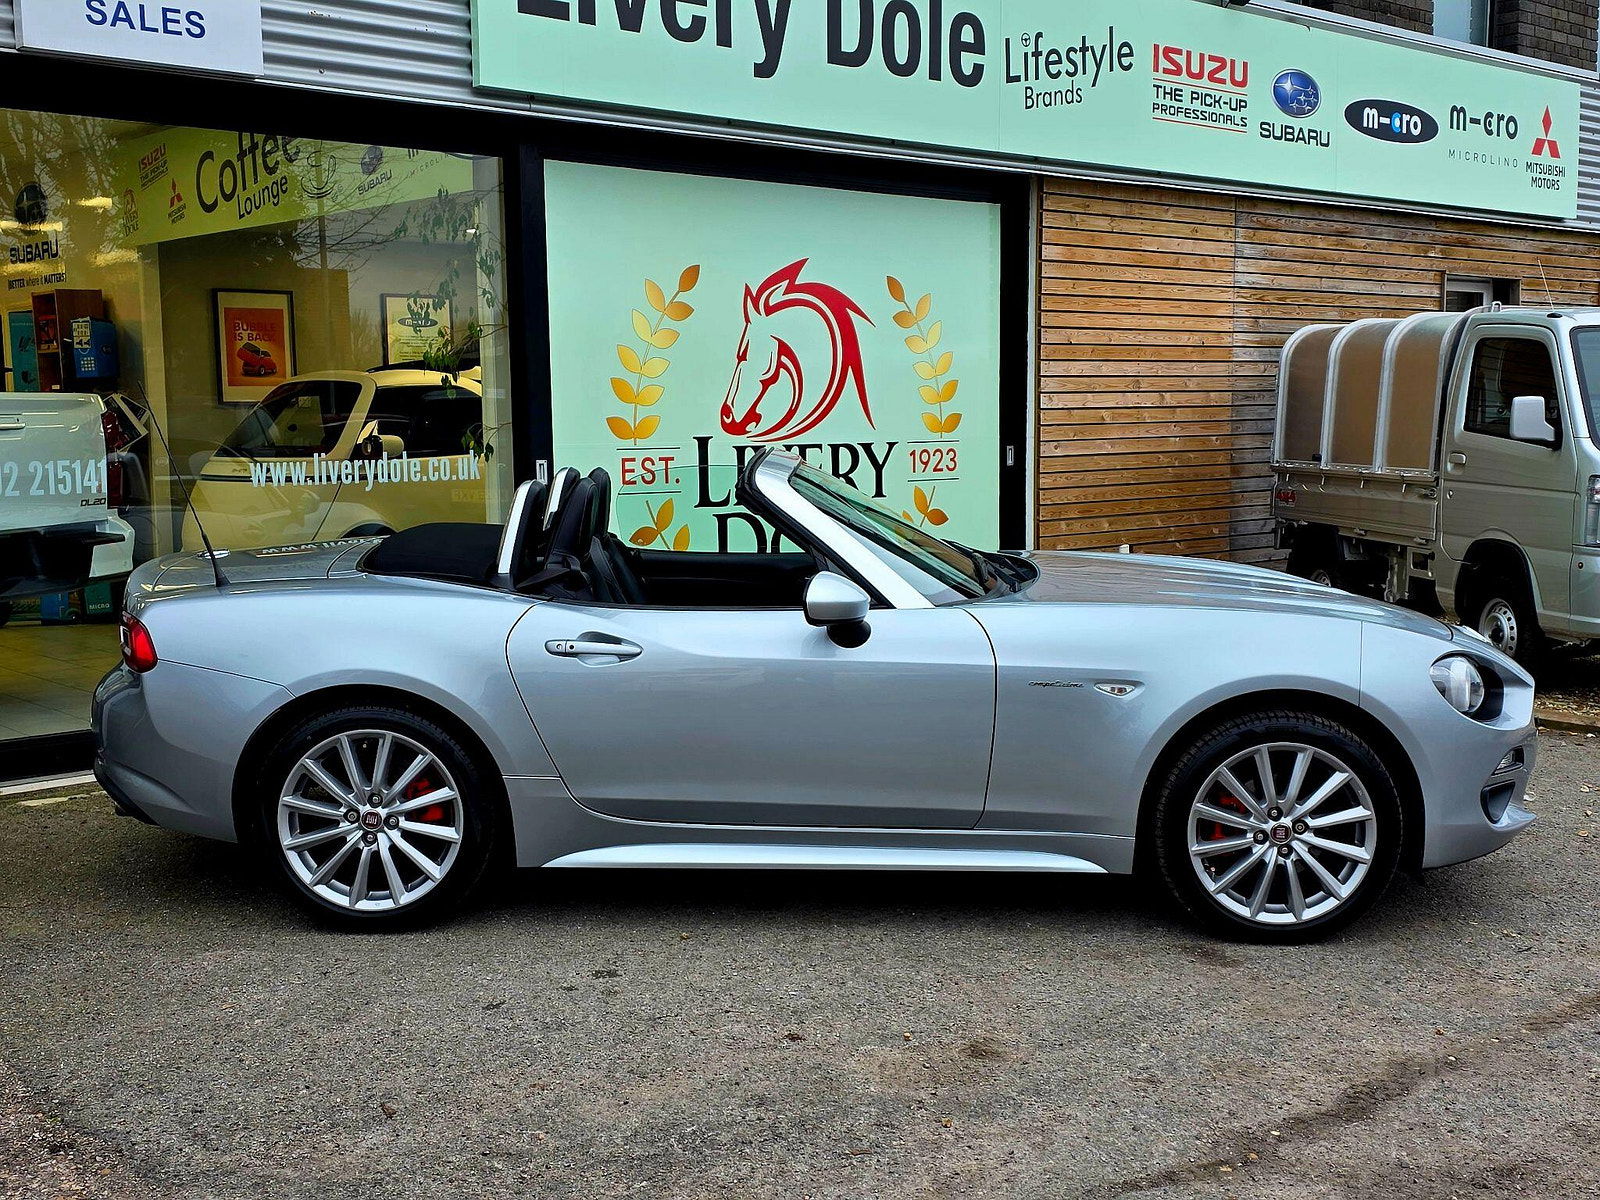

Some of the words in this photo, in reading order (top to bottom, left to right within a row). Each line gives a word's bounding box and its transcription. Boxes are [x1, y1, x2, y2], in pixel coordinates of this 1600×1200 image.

[85, 0, 206, 39] SALES
[826, 0, 986, 88] Dole
[1004, 25, 1135, 88] Lifestyle
[1152, 43, 1249, 89] ISUZU
[1024, 79, 1084, 110] Brands
[1152, 84, 1184, 103] THE
[1189, 90, 1248, 113] PICK-UP
[1152, 102, 1248, 127] PROFESSIONALS
[1259, 121, 1331, 148] SUBARU
[1447, 149, 1519, 169] MICROLINO
[1525, 161, 1567, 178] MITSUBISHI
[236, 175, 289, 220] Lounge
[1530, 176, 1561, 191] MOTORS
[9, 239, 59, 265] SUBARU
[250, 450, 481, 492] www.liverydole.co.uk
[620, 456, 681, 485] EST.
[908, 448, 958, 474] 1923
[0, 461, 20, 497] 2
[28, 458, 107, 496] 215141
